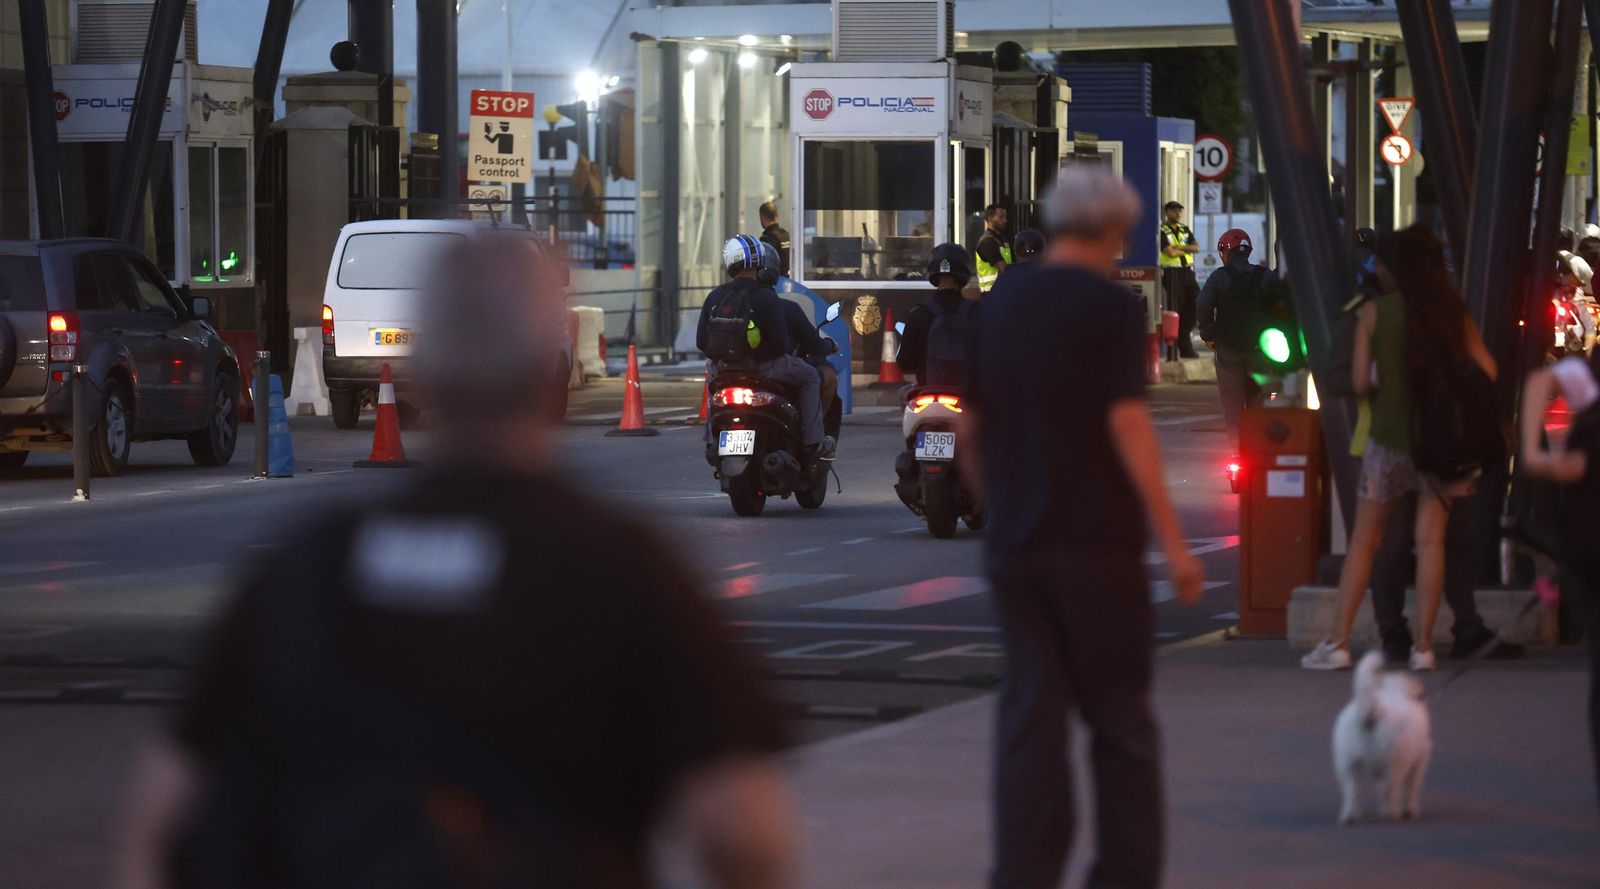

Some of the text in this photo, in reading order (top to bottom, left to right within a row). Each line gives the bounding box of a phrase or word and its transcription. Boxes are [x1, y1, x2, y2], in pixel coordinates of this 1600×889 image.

[75, 97, 135, 109] POLIC
[477, 95, 529, 113] STOP
[806, 97, 831, 111] STOP
[838, 97, 914, 107] POLICIA
[474, 155, 525, 167] Passport
[1196, 147, 1223, 167] 10
[479, 167, 520, 178] control
[1119, 270, 1146, 279] STOP
[727, 432, 753, 443] 3304
[926, 434, 954, 446] 5060
[729, 442, 749, 453] JHV
[924, 445, 946, 457] LZK
